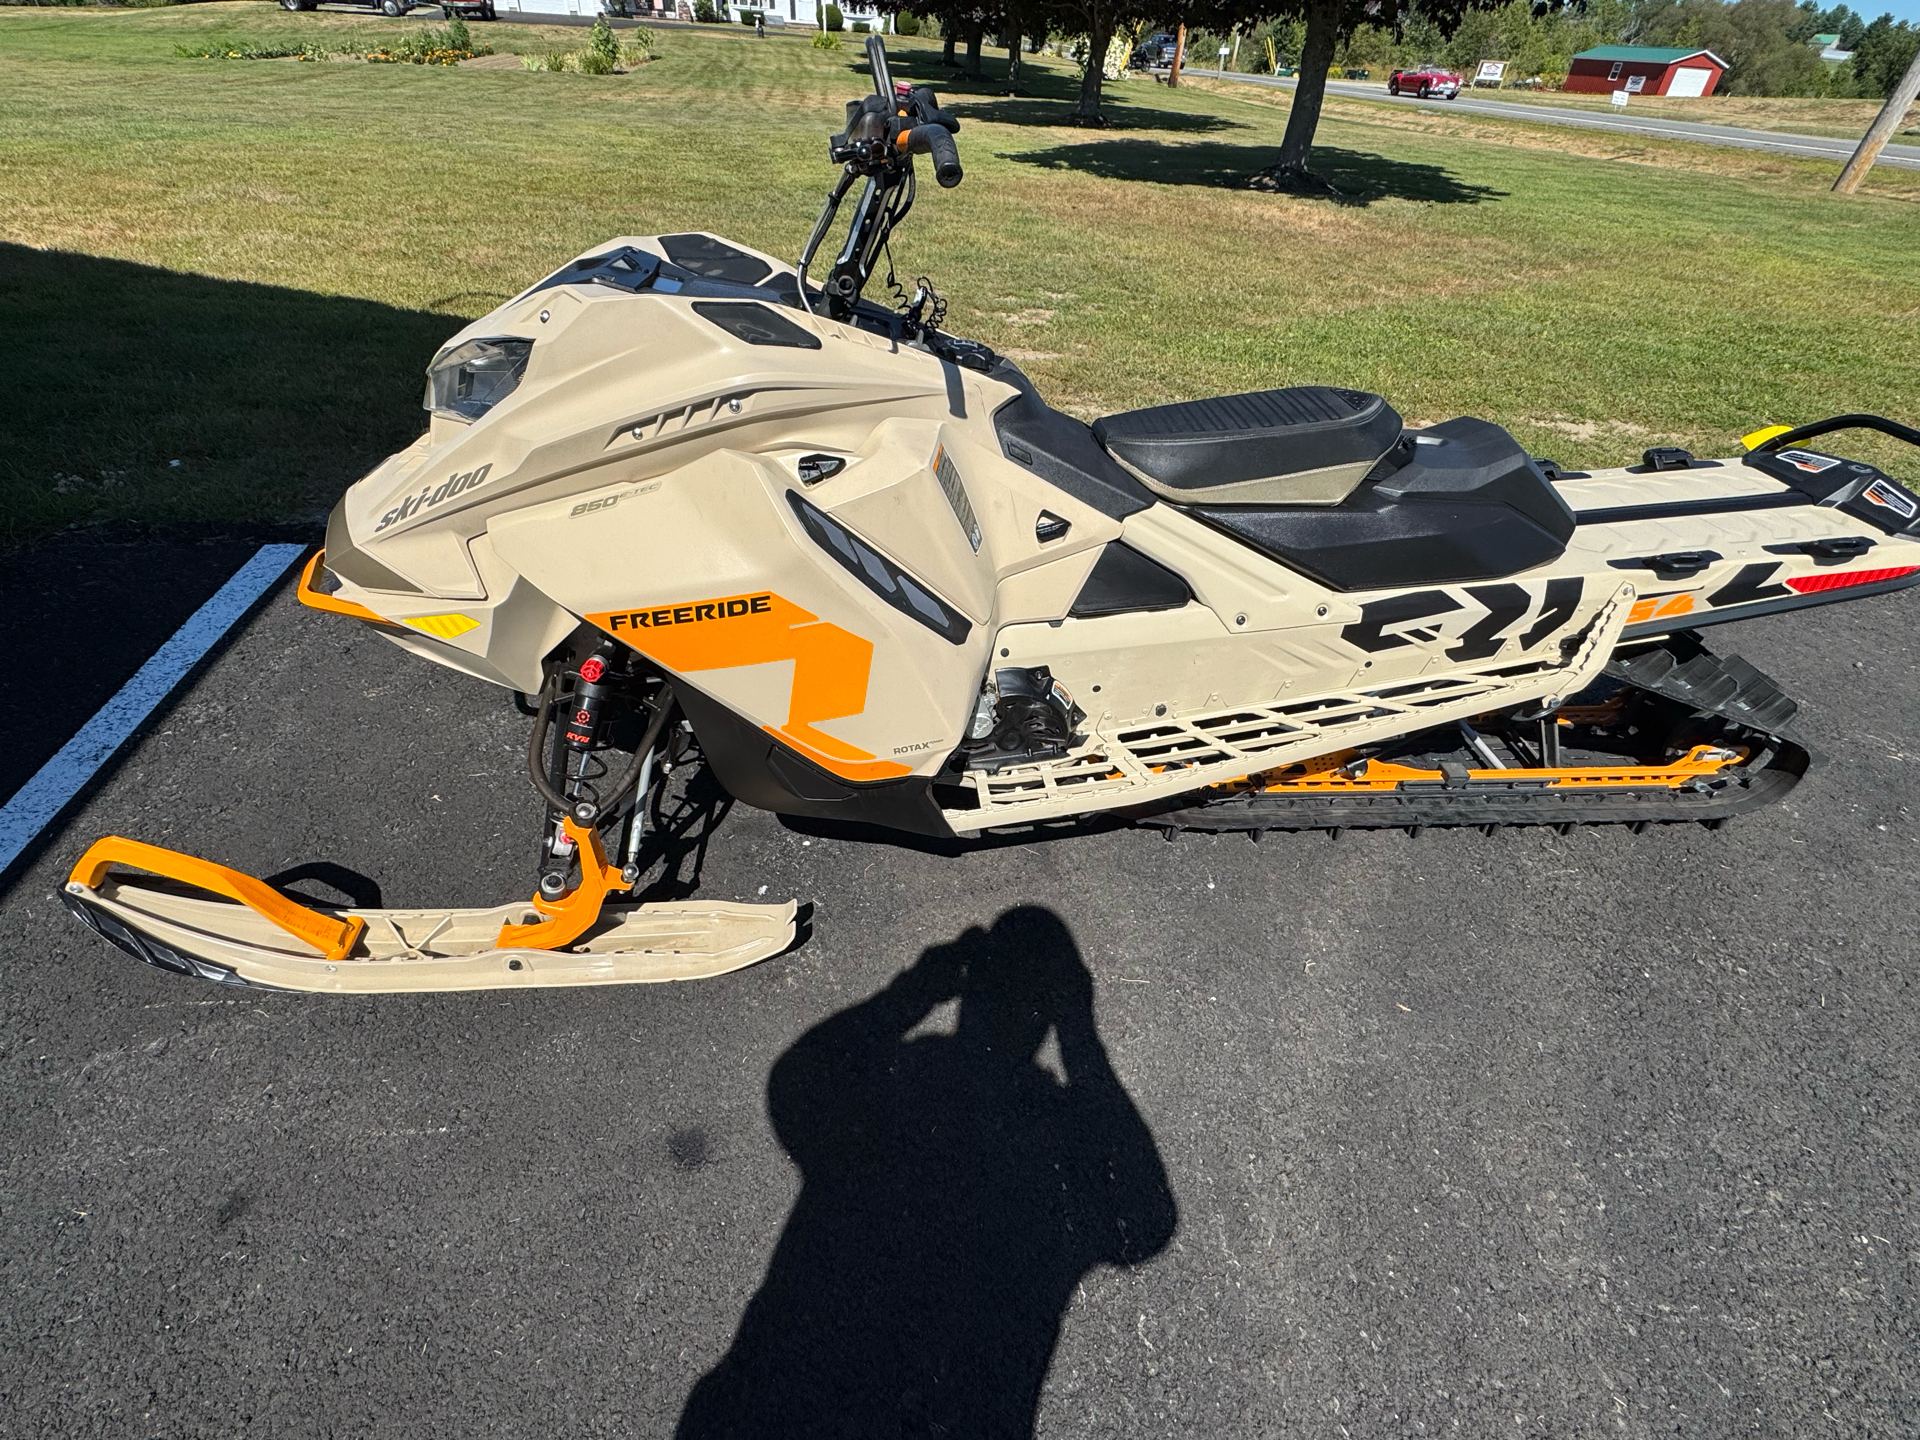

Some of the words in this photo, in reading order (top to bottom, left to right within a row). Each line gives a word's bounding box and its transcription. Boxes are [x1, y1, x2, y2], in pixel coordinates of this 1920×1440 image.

[374, 463, 493, 532] ski-doo
[571, 495, 620, 517] 850
[609, 595, 772, 631] FREERIDE
[893, 741, 930, 755] ROTAX
